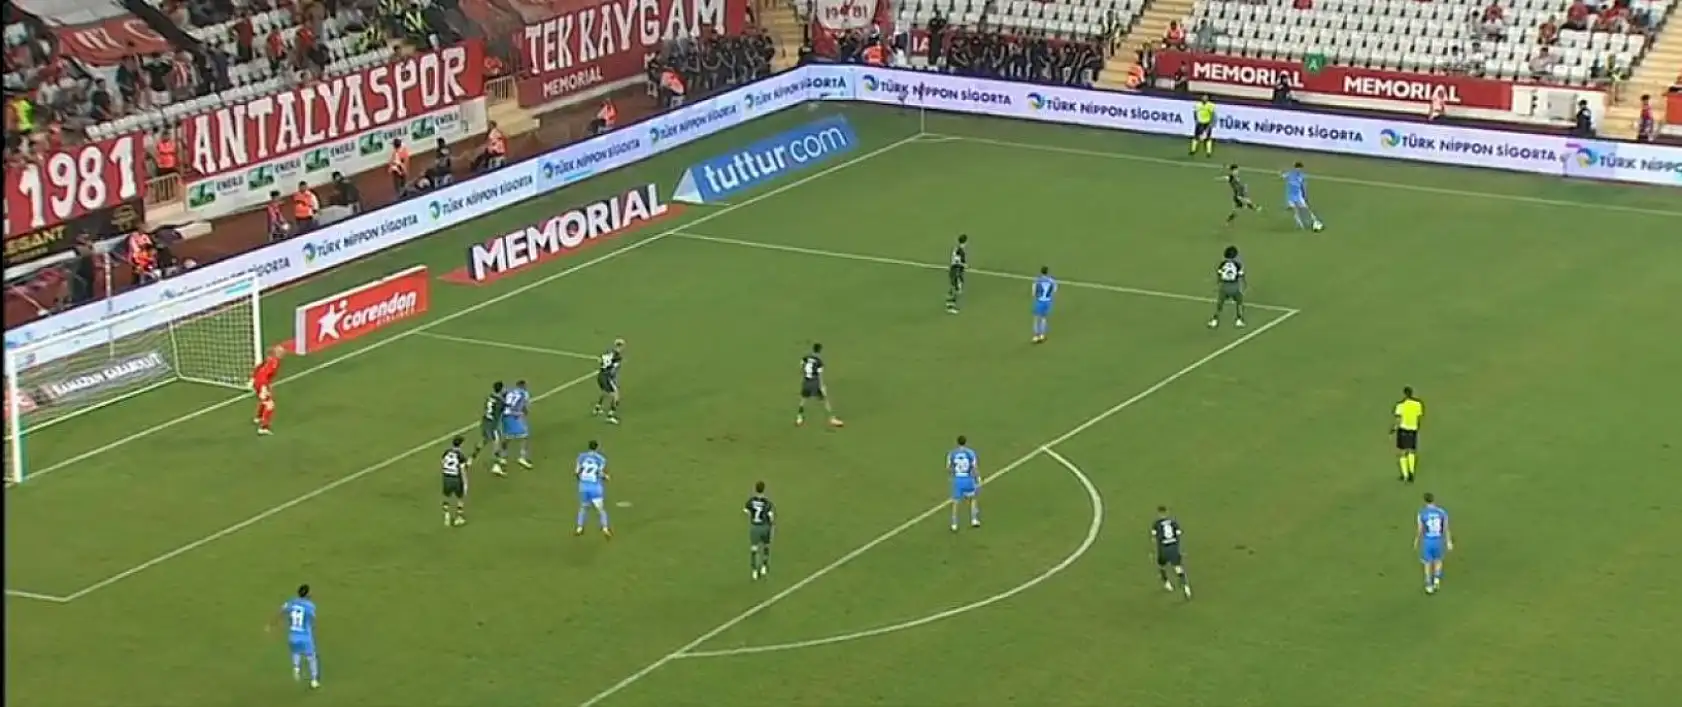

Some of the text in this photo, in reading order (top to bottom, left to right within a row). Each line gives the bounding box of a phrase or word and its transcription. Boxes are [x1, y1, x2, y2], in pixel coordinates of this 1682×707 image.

[525, 14, 574, 75] TEK
[543, 66, 604, 98] MEMORIAL
[880, 79, 908, 94] TÜRK
[193, 47, 466, 176] ANTALYASPOR
[1047, 97, 1183, 123] TÜRK NİPPON SİGORTA
[1219, 115, 1363, 142] TÜRK NİPPON SİGORTA
[1401, 133, 1556, 161] TÜRK NİPPON SİGORTA
[19, 136, 137, 229] 1981
[317, 239, 341, 256] TÜRK
[470, 182, 669, 281] MEMORIAL
[343, 291, 417, 331] corendon
